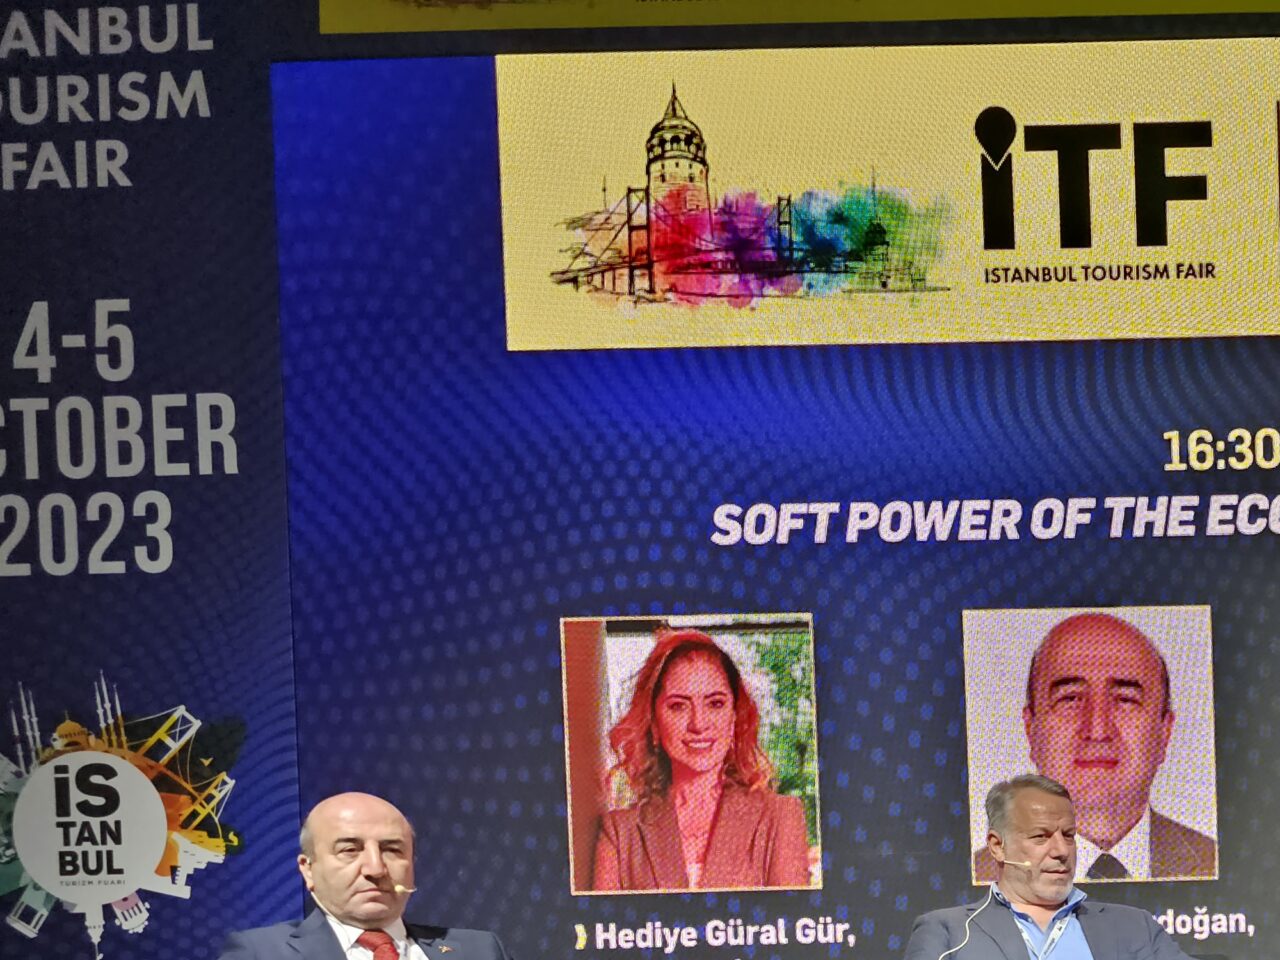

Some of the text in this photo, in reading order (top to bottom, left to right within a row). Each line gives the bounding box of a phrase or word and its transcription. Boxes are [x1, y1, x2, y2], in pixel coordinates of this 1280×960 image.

[0, 70, 211, 125] URISM
[1, 139, 132, 191] FAIR
[984, 262, 1216, 284] ISTANBUL TOURISM FAIR
[13, 298, 135, 383] 4-5
[0, 393, 239, 480] TOBER
[0, 491, 173, 577] 2023
[710, 501, 840, 545] SOFT
[845, 498, 1020, 544] POWER
[1030, 497, 1096, 540] OF
[1104, 495, 1199, 538] THE
[56, 820, 122, 846] TAN
[58, 850, 124, 876] BUL
[595, 917, 856, 953] Hediye Güral Gür,
[1152, 905, 1255, 941] doğan,
